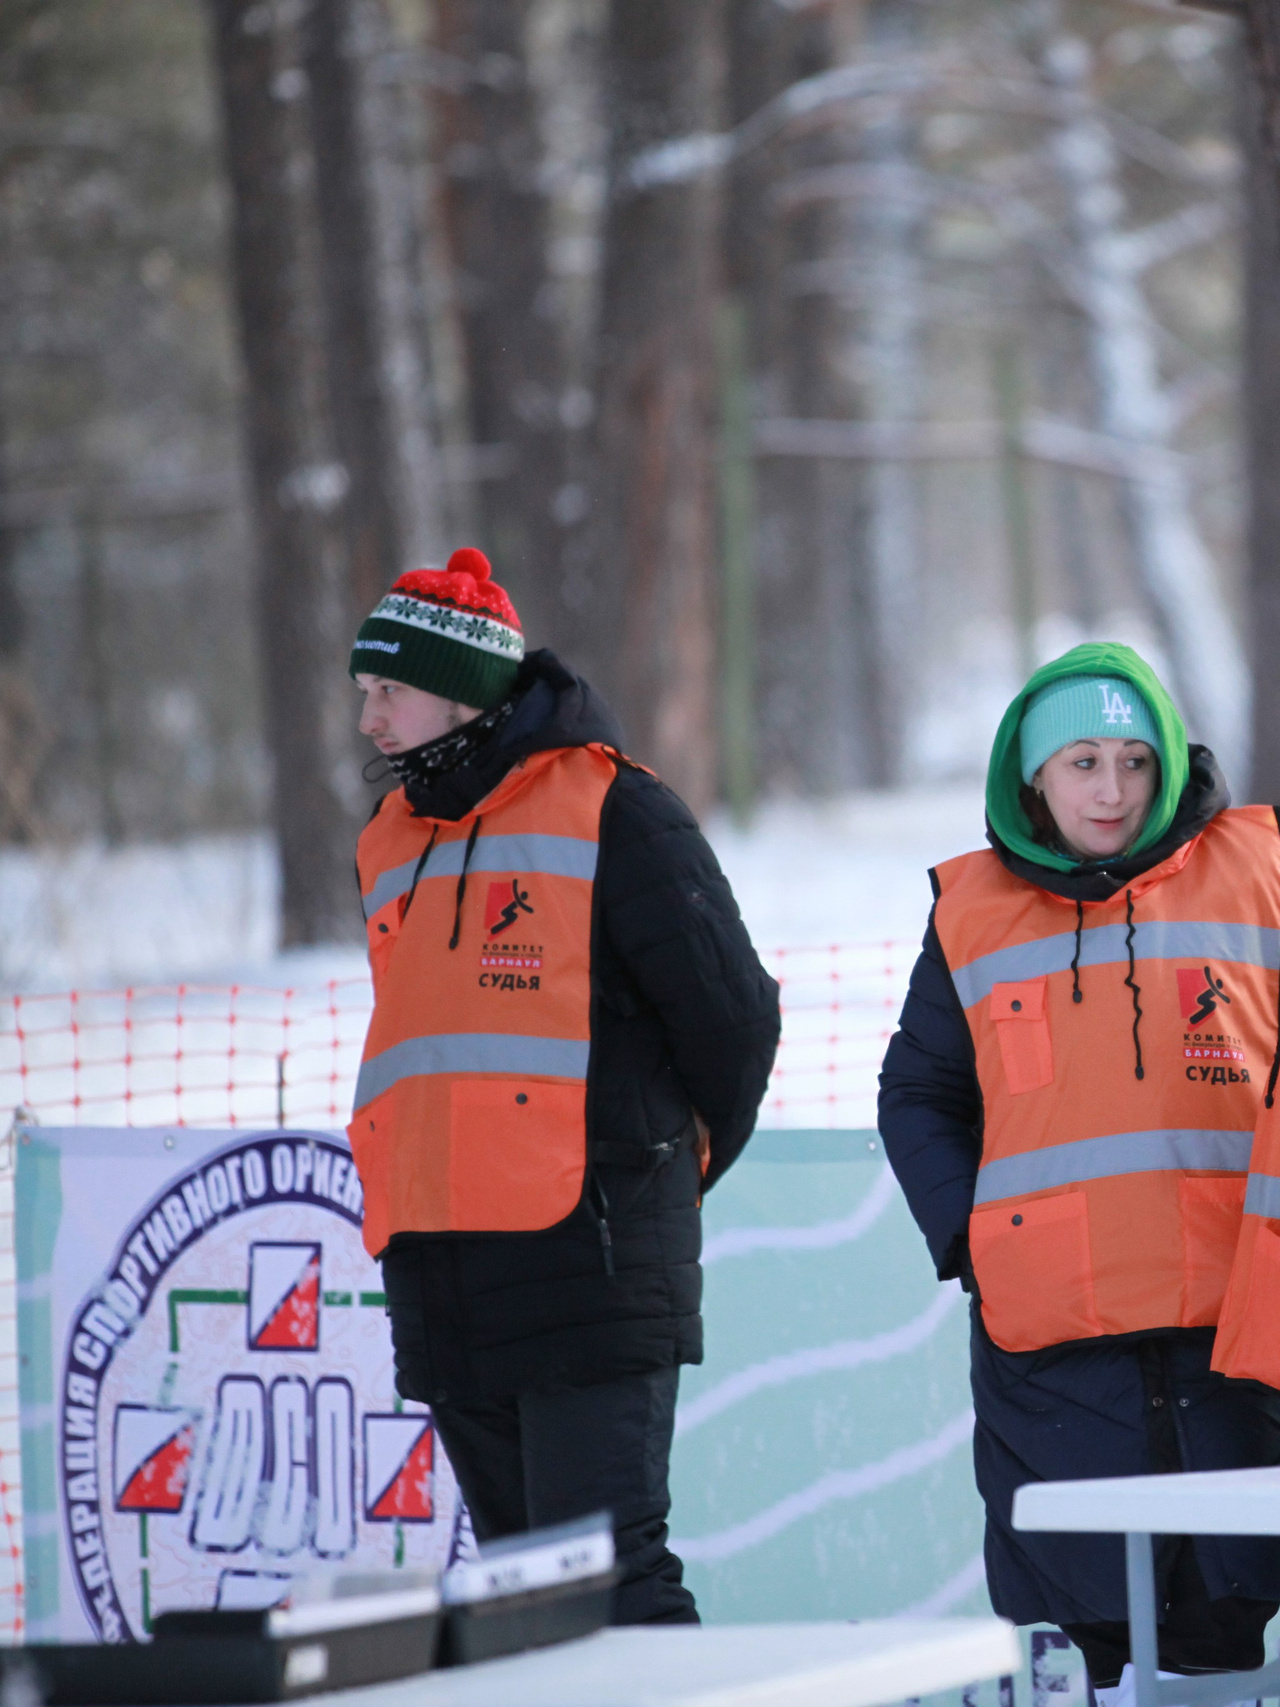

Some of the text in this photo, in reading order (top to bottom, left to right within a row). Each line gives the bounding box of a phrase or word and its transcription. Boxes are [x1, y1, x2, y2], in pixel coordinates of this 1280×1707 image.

[1098, 684, 1132, 723] LA
[482, 944, 543, 952] КОМИТЕТ
[481, 958, 540, 967] БАРНАУЛ
[478, 972, 541, 991] СУДЬЯ
[1183, 1034, 1241, 1044] КОМИТЕТ
[1185, 1049, 1245, 1061] БАРНАУЛ
[1185, 1066, 1251, 1086] СУДЬЯ
[72, 1148, 268, 1371] СПОРТИВНОГО
[271, 1143, 366, 1220] ОРИЕН
